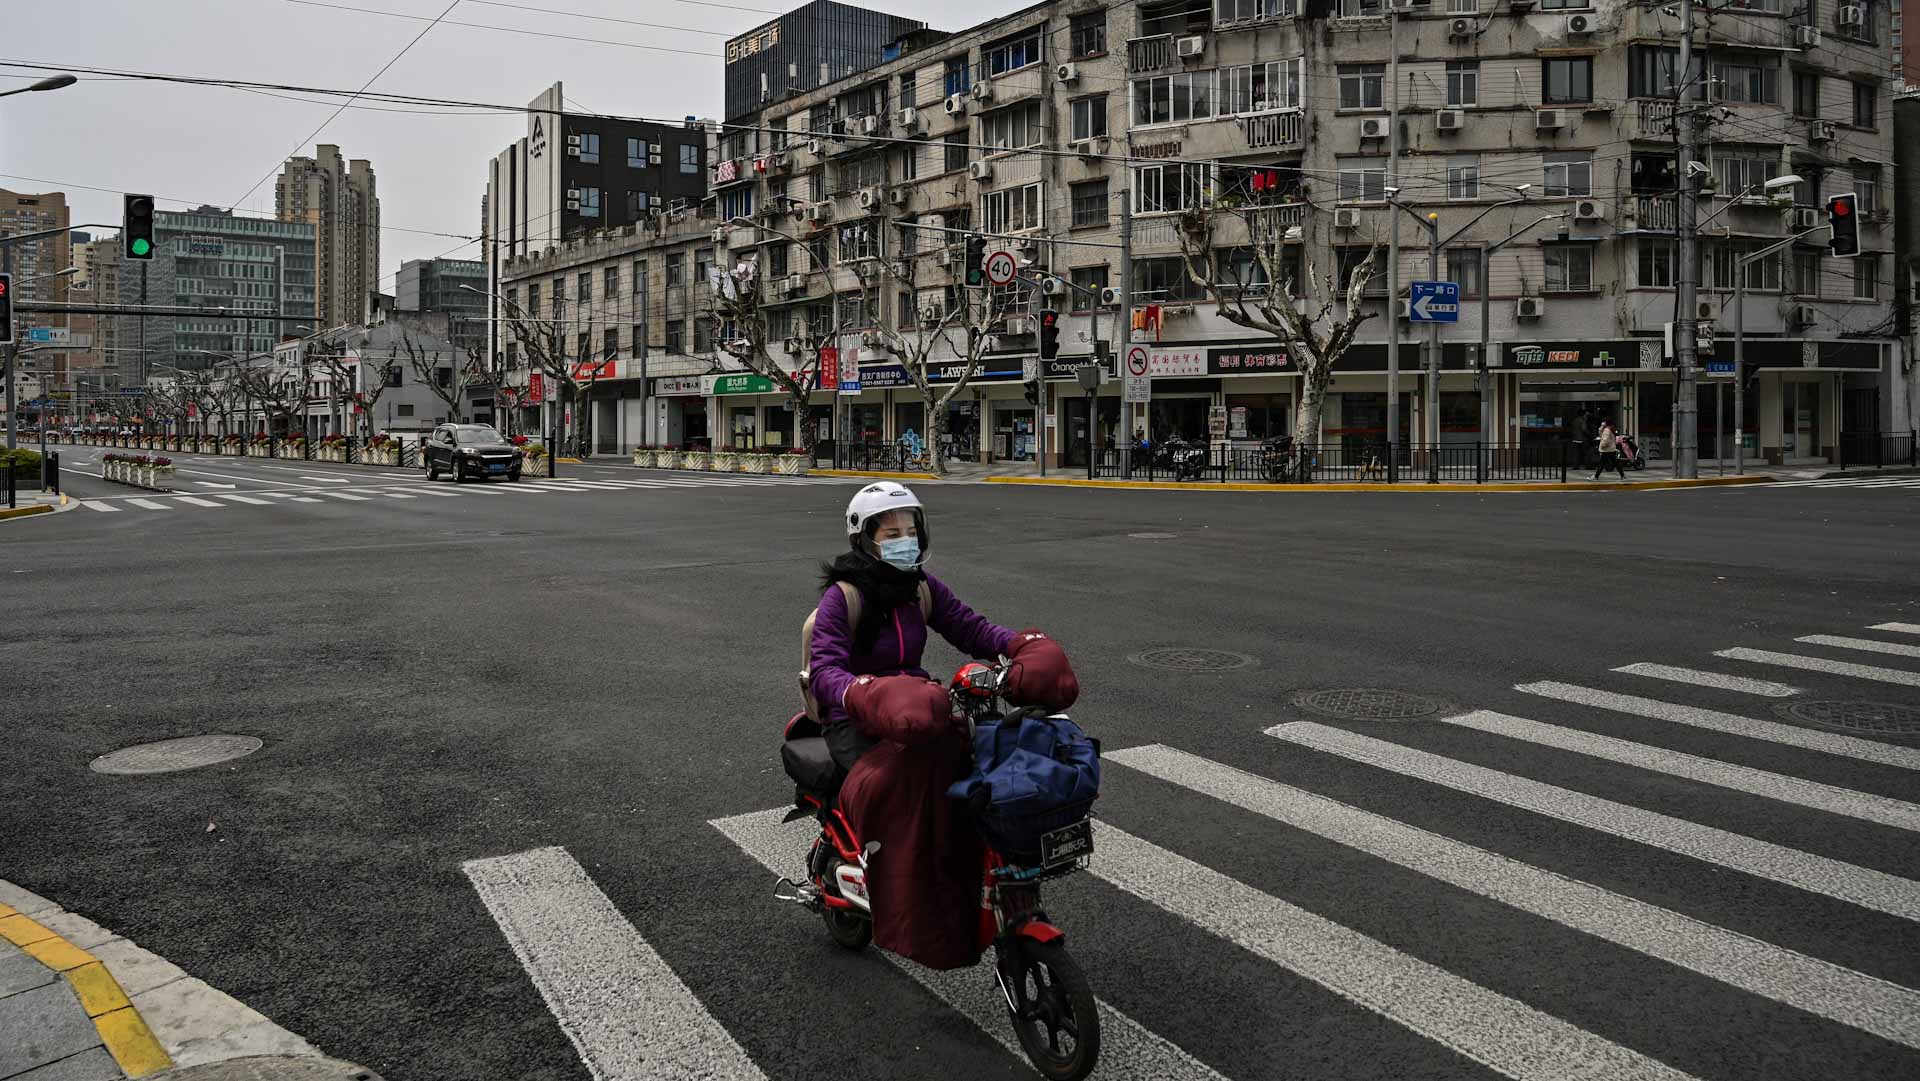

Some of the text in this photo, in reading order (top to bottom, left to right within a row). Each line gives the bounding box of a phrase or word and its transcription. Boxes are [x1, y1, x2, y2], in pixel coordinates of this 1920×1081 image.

[991, 261, 1011, 277] 40
[1415, 284, 1455, 295] 下一路口
[1547, 350, 1580, 363] KEDI
[940, 365, 985, 378] LAWSN
